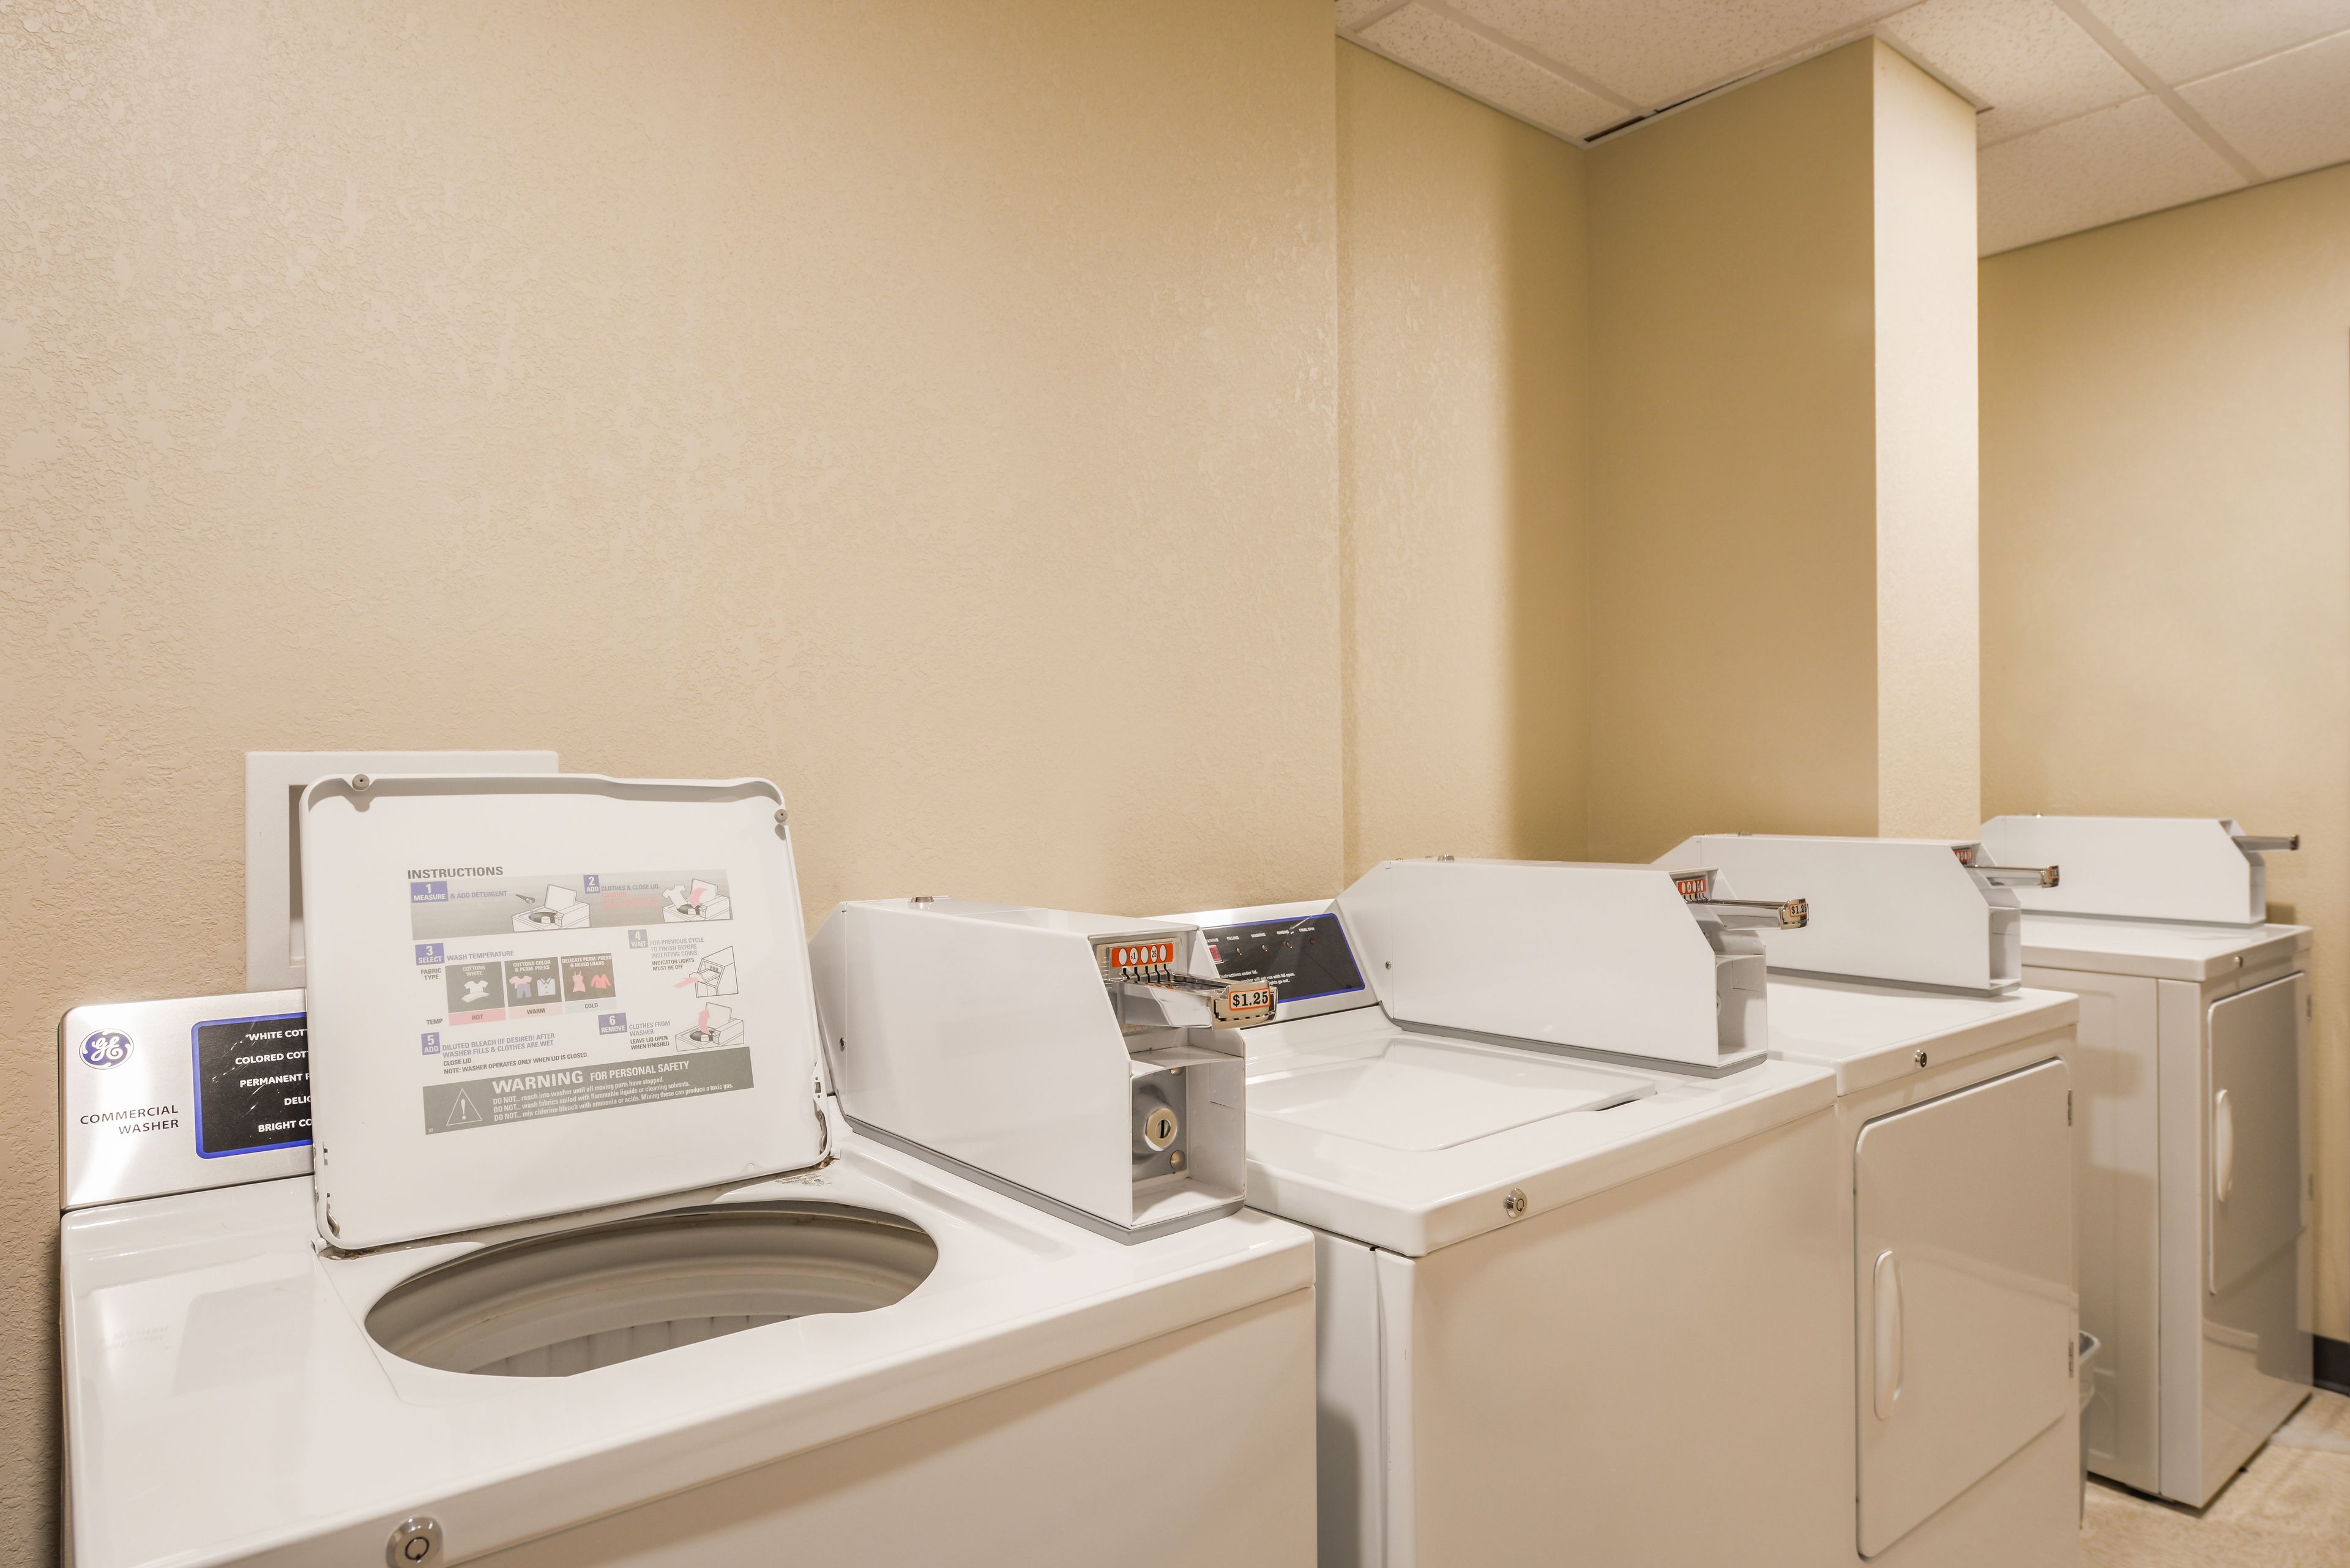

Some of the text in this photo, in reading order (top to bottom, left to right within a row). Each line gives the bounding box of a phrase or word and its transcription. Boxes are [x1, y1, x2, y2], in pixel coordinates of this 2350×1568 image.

[408, 867, 503, 879] INSTRUCTIONS
[588, 876, 595, 885] 2
[426, 884, 431, 893] 1
[1791, 904, 1807, 914] $1.25
[635, 931, 641, 940] 4
[426, 946, 433, 955] 3
[469, 950, 514, 959] TEMPERATURE
[1233, 991, 1268, 1007] $1.25
[609, 1016, 615, 1025] 6
[427, 1035, 434, 1045] 5
[507, 1035, 534, 1043] DESIRED)
[498, 1043, 524, 1051] CLOTHES
[235, 1053, 284, 1065] COLORED
[240, 1073, 302, 1087] PERMANENT
[492, 1061, 689, 1094] WARNING FOR PERSONAL SAFETY
[643, 1076, 664, 1085] stopped.
[534, 1105, 558, 1115] chlorine
[559, 1103, 578, 1111] bleach
[685, 1086, 705, 1095] produce
[539, 1098, 558, 1107] fabrics
[591, 1091, 619, 1099] flammable
[620, 1088, 637, 1096] liquids
[80, 1105, 178, 1124] COMMERCIAL
[119, 1119, 179, 1134] WASHER
[258, 1121, 296, 1132] BRIGHT
